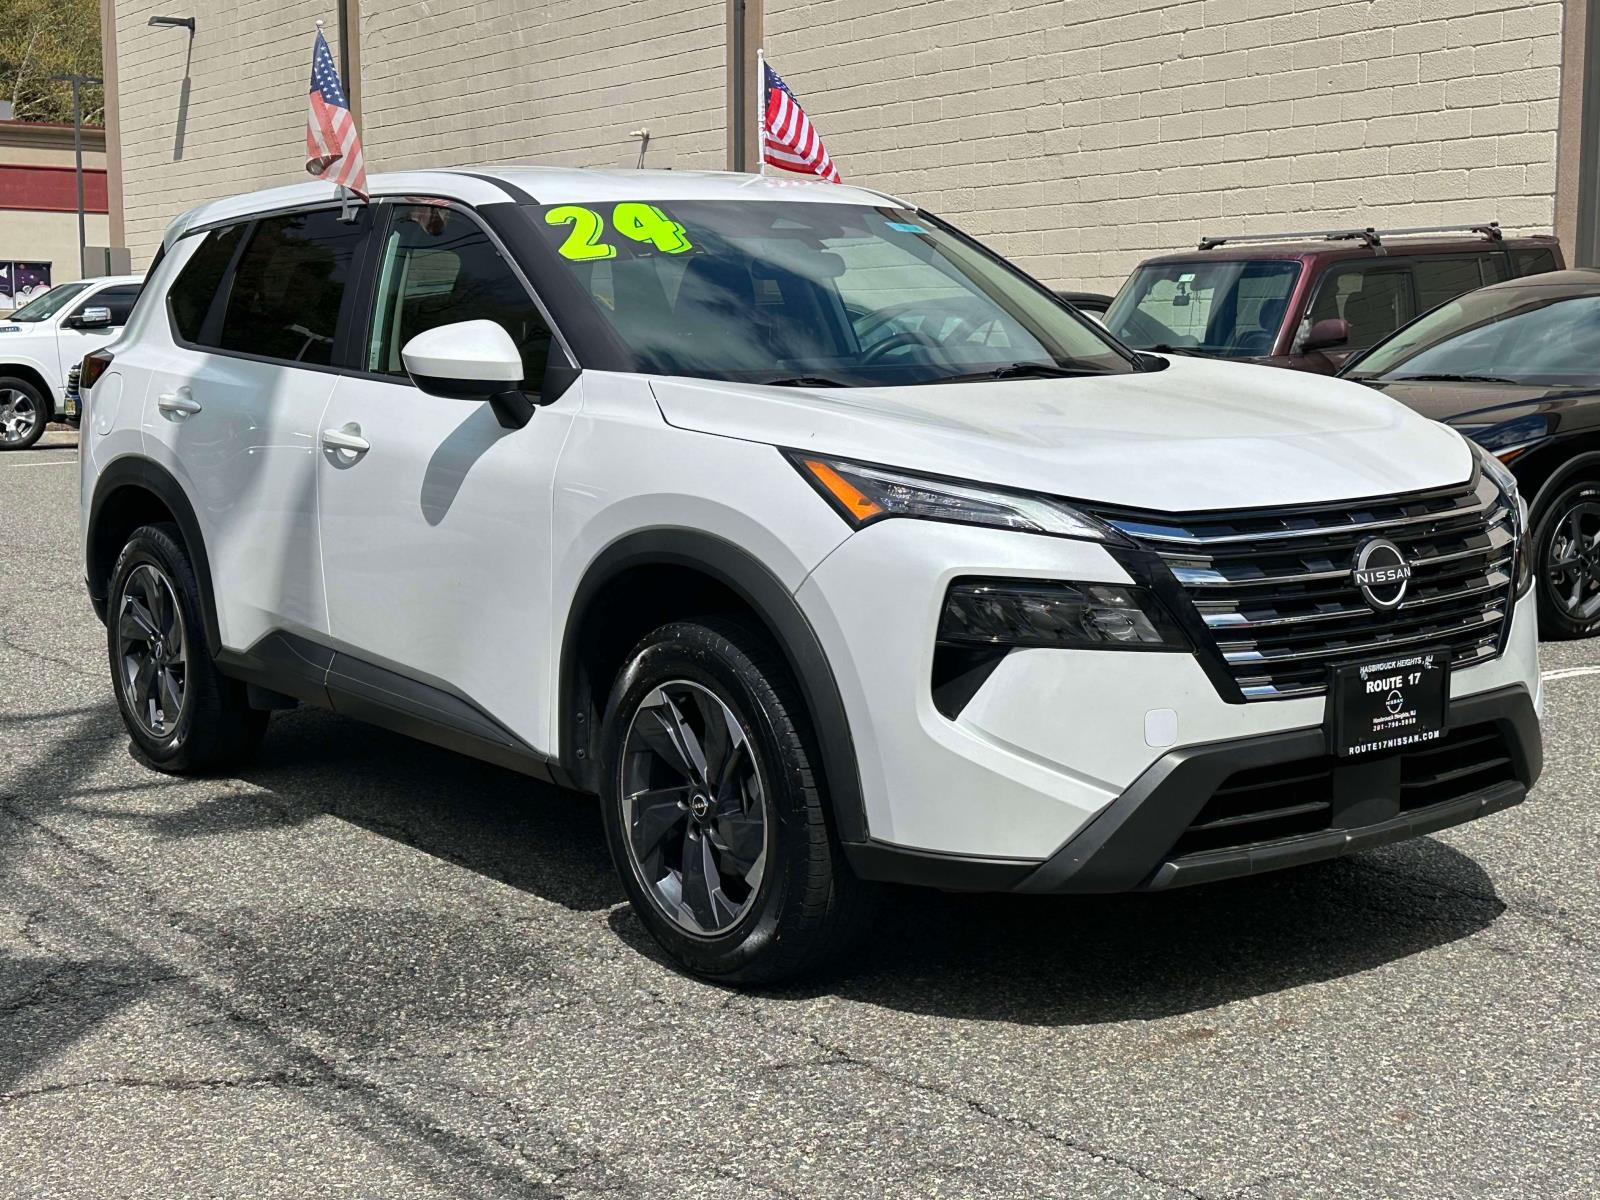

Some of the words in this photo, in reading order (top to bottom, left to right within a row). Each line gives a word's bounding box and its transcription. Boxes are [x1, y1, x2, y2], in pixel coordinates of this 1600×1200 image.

[544, 202, 692, 262] 24
[1356, 566, 1411, 584] NISSAN
[1360, 661, 1396, 674] HASBROUCK
[1366, 675, 1403, 694] ROUTE
[1408, 672, 1421, 685] 17
[1349, 730, 1439, 755] ROUTE17NISSAN.COM
